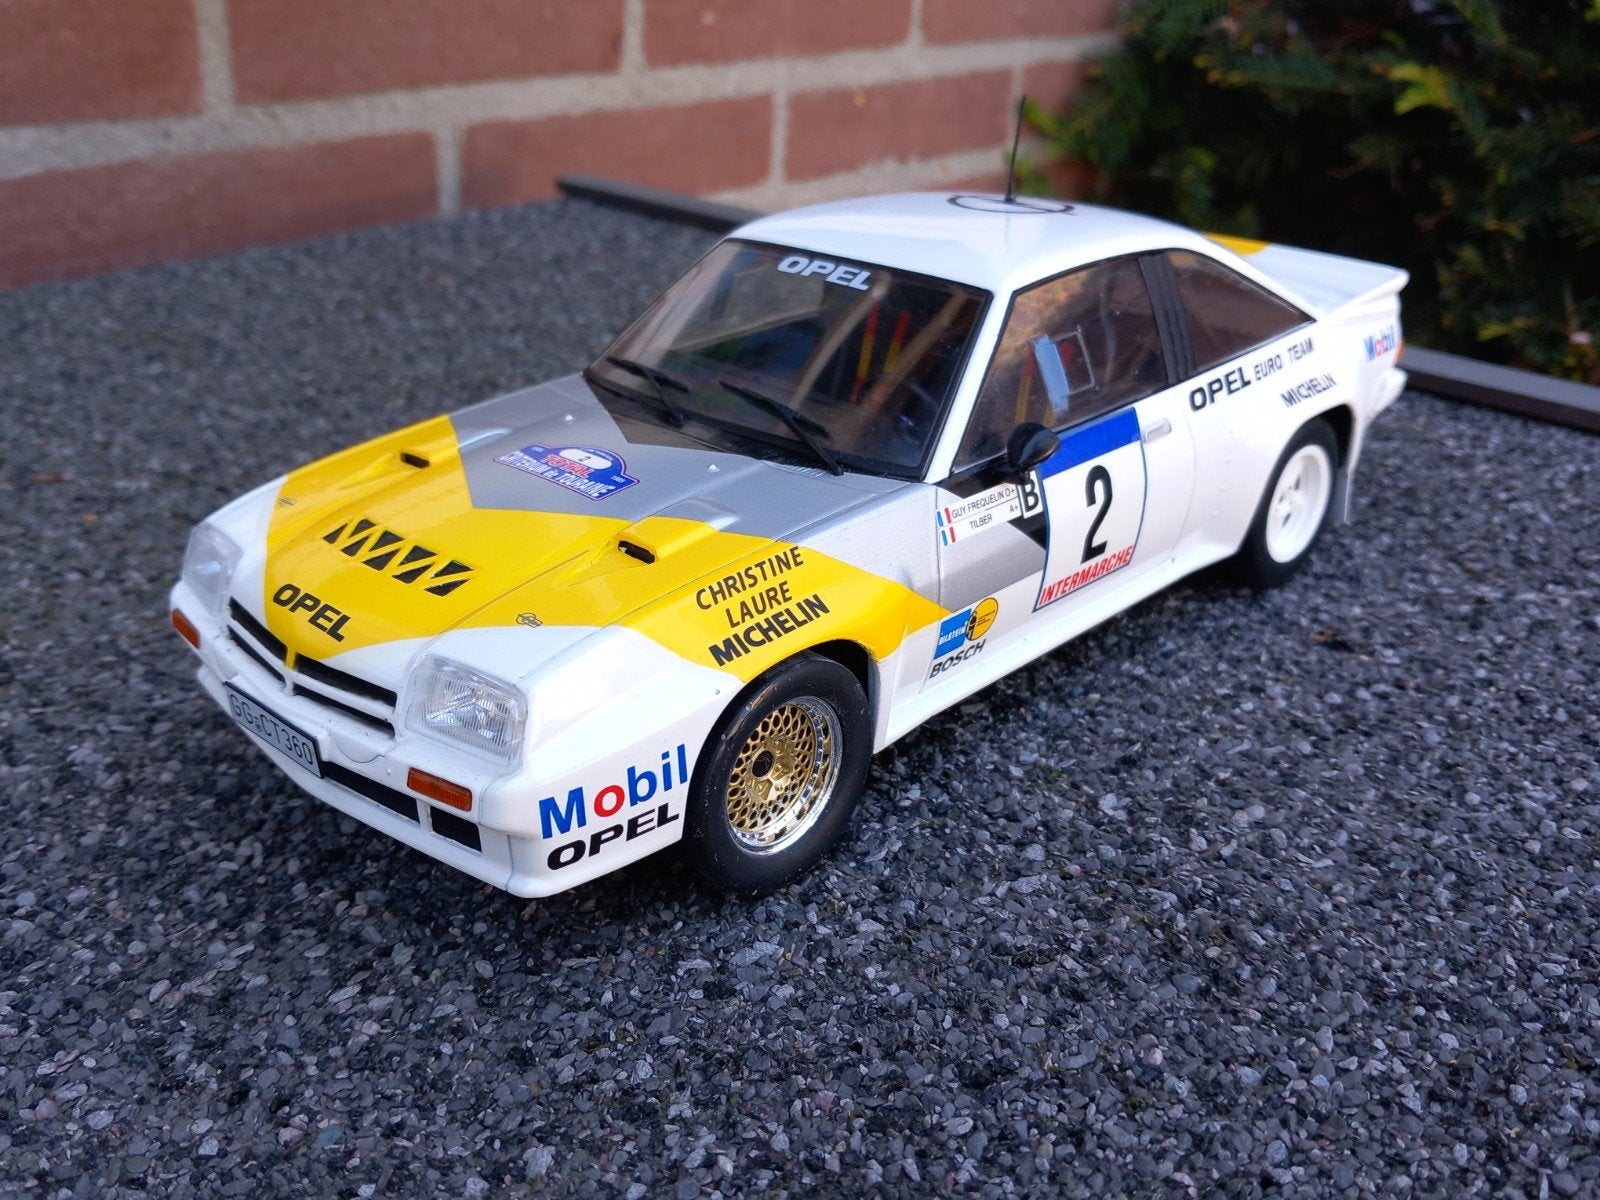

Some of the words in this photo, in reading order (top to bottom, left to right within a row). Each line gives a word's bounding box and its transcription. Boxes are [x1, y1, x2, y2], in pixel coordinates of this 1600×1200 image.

[777, 256, 871, 291] OPEL
[1364, 326, 1395, 361] Mobil
[1188, 366, 1251, 412] OPEL
[1253, 354, 1284, 381] EURO
[1287, 337, 1315, 363] TEAM
[1280, 373, 1338, 408] MICHELIN
[541, 454, 596, 479] TOTAL
[555, 473, 617, 498] TOURAINE
[951, 505, 967, 519] GUY
[967, 491, 1004, 513] FREQUELIN
[1020, 477, 1039, 513] B
[1080, 464, 1113, 566] 2
[969, 513, 993, 530] TILBER
[695, 546, 804, 611] CHRISTINE
[1038, 545, 1133, 605] INTERMARCHE
[272, 583, 351, 643] OPEL
[725, 580, 793, 629] LAURE
[708, 593, 831, 667] MICHELIN
[929, 638, 987, 680] BOSCH
[538, 743, 689, 840] Mobil
[547, 802, 680, 871] OPEL
